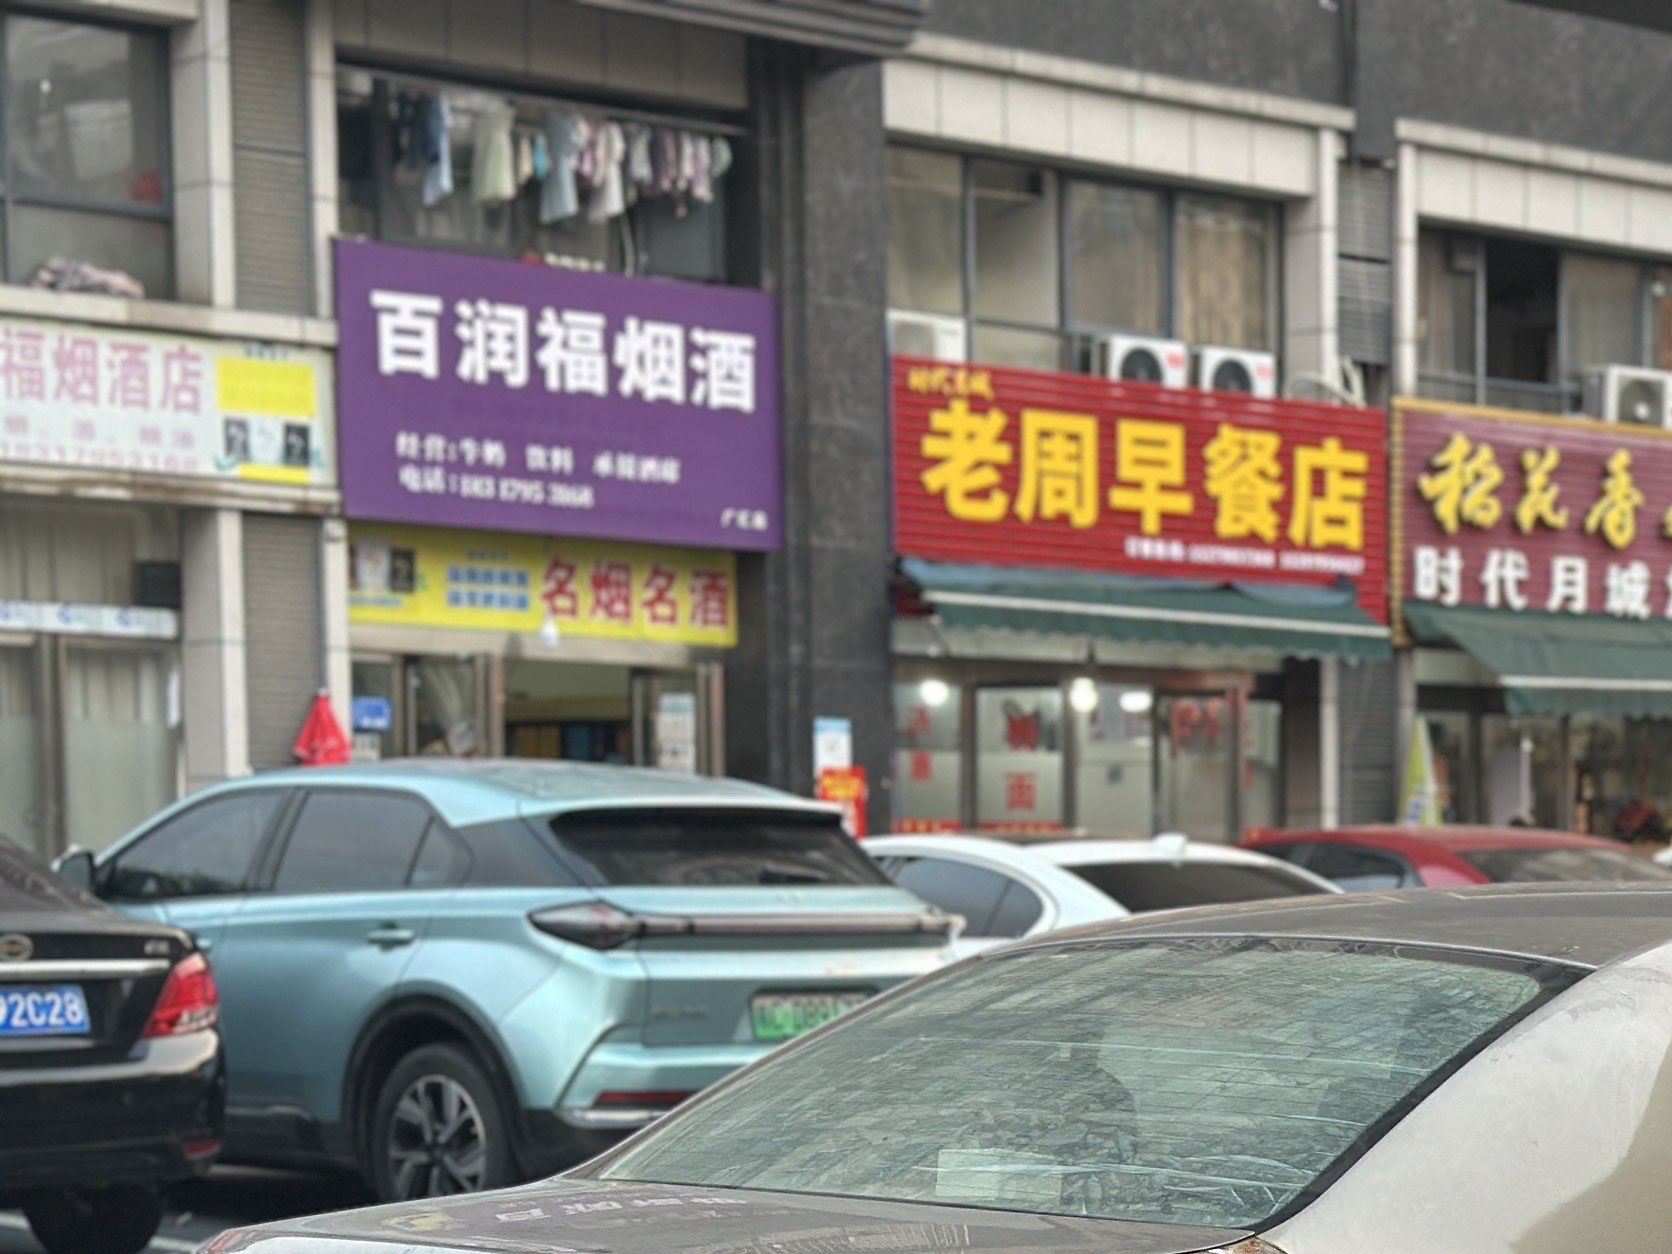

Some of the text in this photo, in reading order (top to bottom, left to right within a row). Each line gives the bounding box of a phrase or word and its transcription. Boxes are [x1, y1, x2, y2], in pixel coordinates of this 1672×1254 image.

[370, 289, 755, 414] 百润福烟酒
[919, 398, 1369, 550] 老周早餐店
[1417, 432, 1644, 549] 稻花香
[540, 556, 729, 628] 名烟名酒
